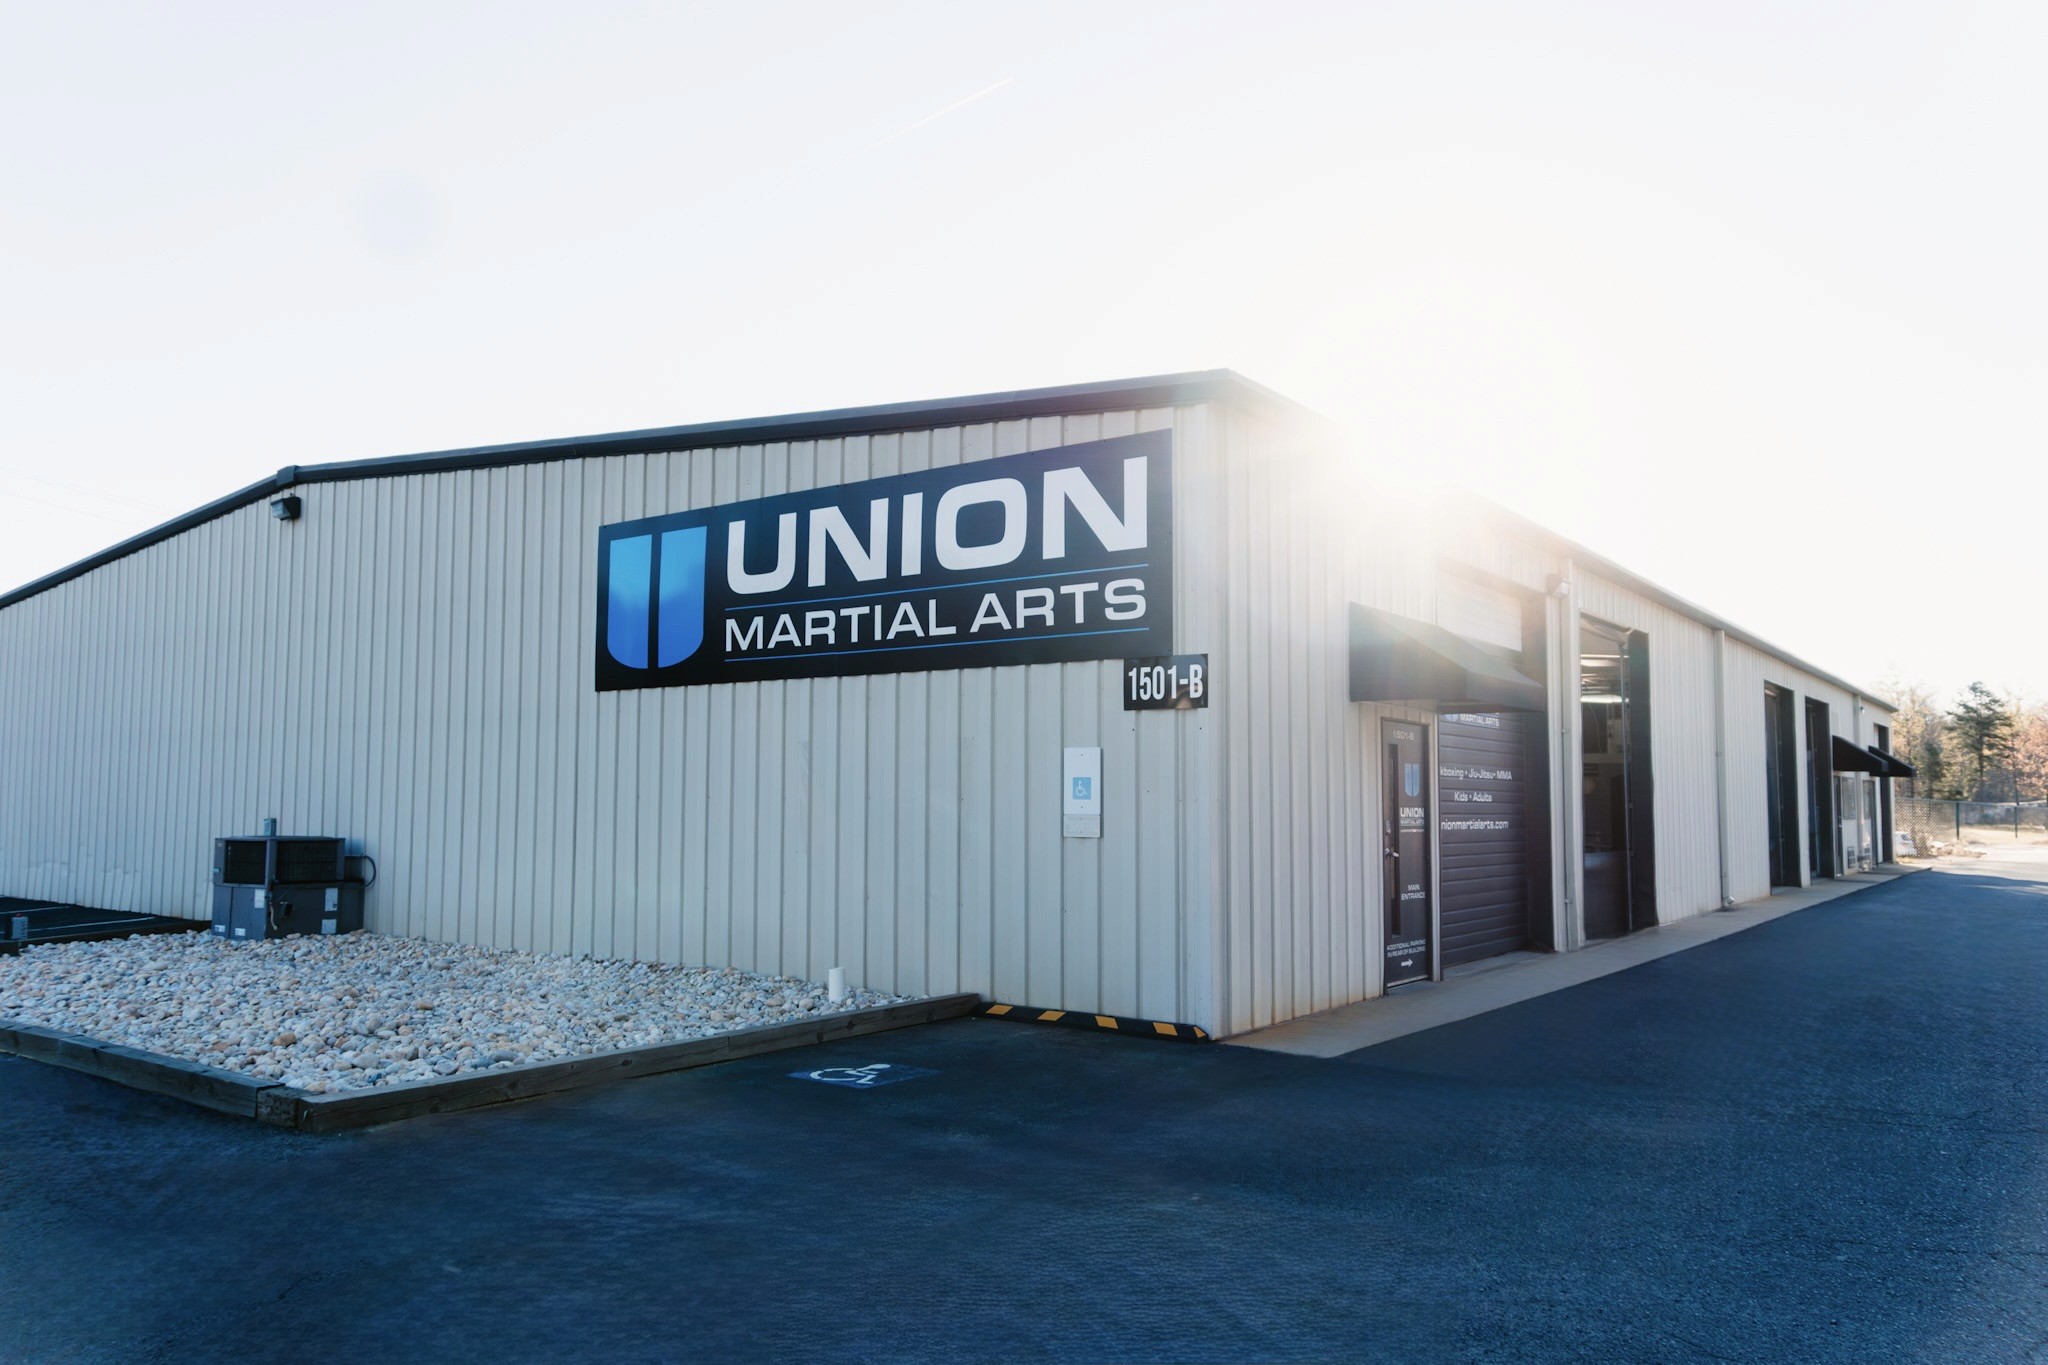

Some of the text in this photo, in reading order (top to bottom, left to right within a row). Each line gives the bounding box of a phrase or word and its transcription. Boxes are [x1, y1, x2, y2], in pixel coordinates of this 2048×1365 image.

[727, 455, 1149, 595] UNION
[724, 577, 1147, 653] MARTIAL ARTS
[1128, 663, 1204, 701] 1501-B
[1496, 770, 1513, 780] MMA
[1454, 791, 1493, 802] Kids Adults
[1400, 807, 1425, 818] UNION
[1407, 884, 1420, 892] MAIN
[1401, 891, 1426, 901] ENTRANCE
